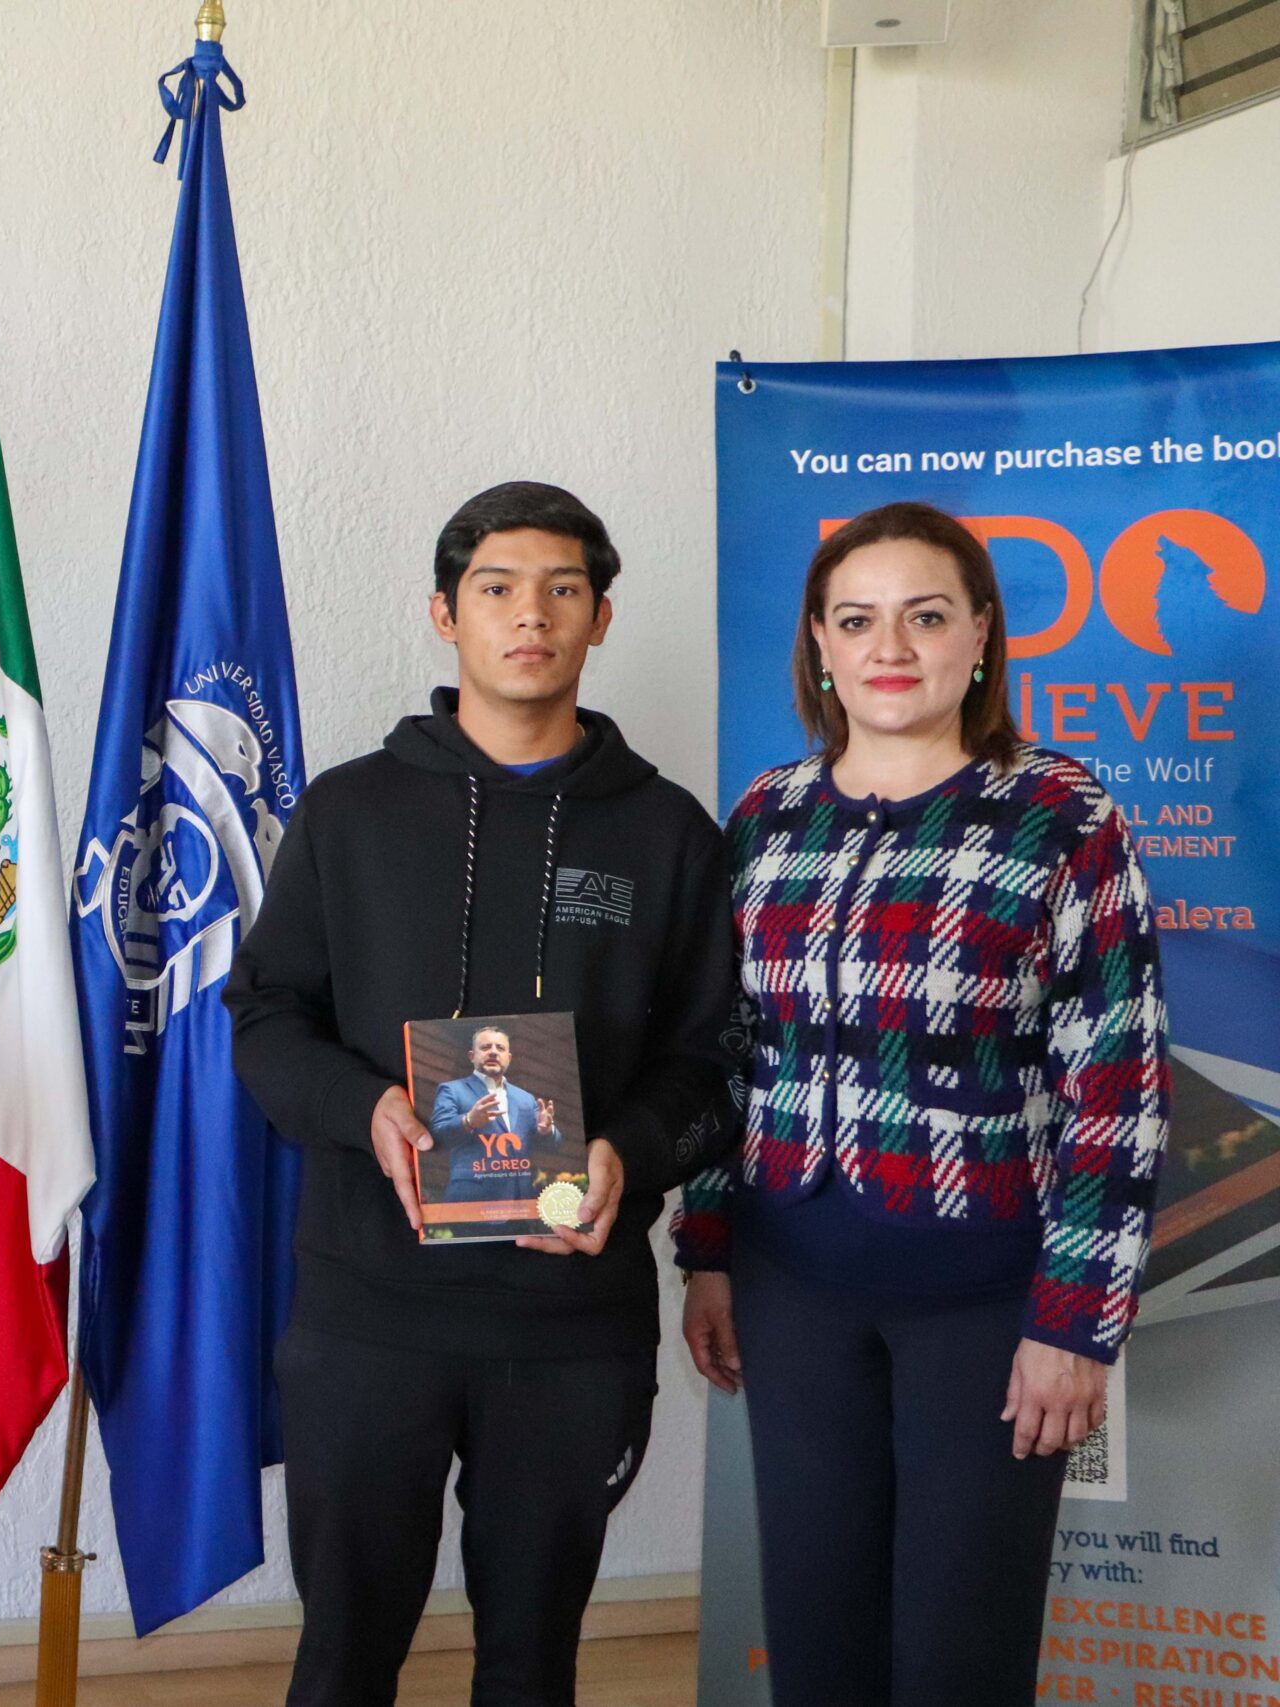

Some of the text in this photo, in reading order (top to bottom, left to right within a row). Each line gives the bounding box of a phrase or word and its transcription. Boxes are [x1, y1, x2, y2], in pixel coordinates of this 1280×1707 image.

[790, 433, 1280, 475] You can now purchase the boo
[184, 661, 296, 809] UNIVERSIDAD VASCO
[1145, 757, 1215, 783] Wolf
[1156, 805, 1213, 826] AND
[555, 905, 631, 926] AMERICAN EAGLE
[1154, 900, 1255, 930] alera
[478, 1132, 522, 1158] YO
[490, 1159, 531, 1171] CREO
[1057, 1529, 1220, 1558] you will find
[1080, 1560, 1143, 1584] with:
[1050, 1595, 1267, 1641] EXCELLENCE
